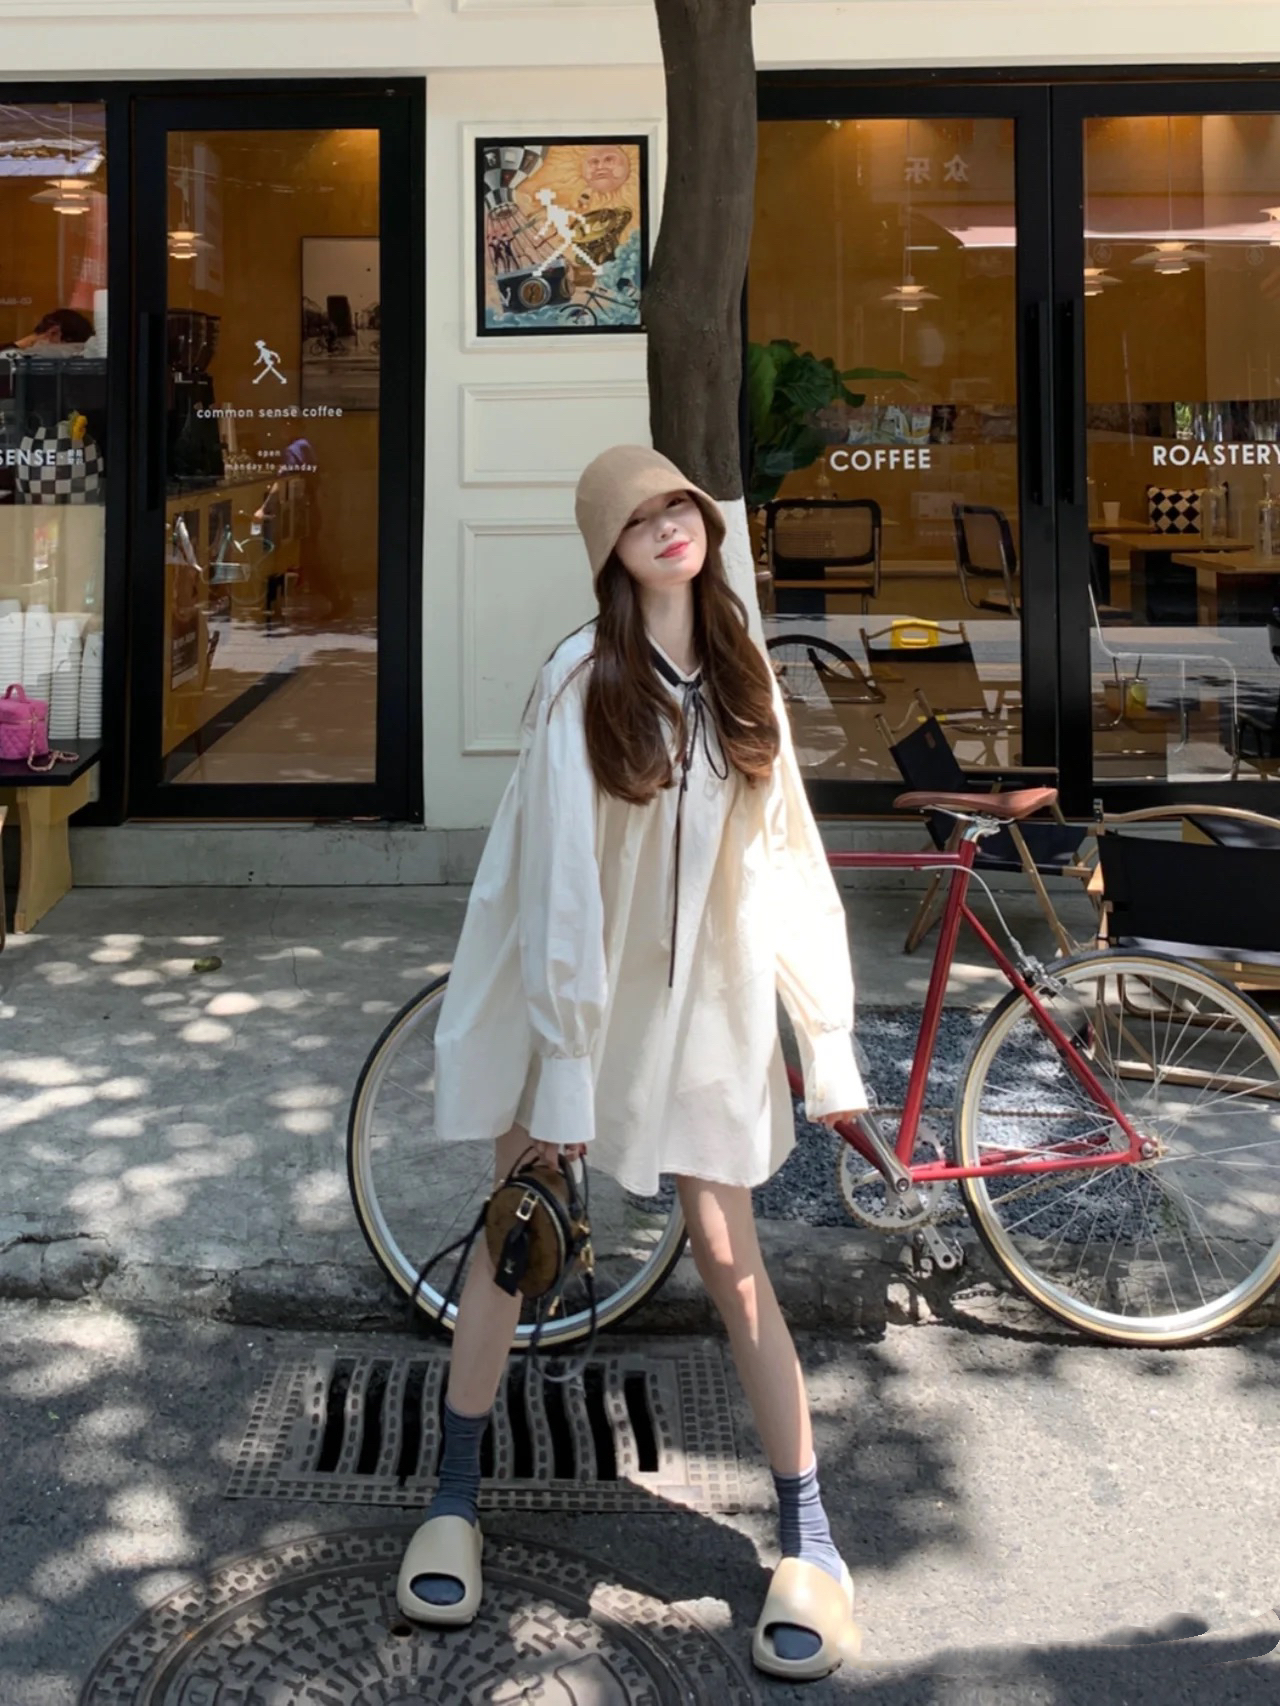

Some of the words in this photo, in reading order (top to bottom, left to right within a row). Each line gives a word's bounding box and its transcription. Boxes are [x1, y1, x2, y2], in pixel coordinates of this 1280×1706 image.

[196, 408, 254, 419] common
[258, 407, 298, 418] sense
[302, 405, 343, 417] coffee
[257, 449, 281, 459] open
[829, 448, 932, 472] COFFEE
[265, 462, 275, 471] to
